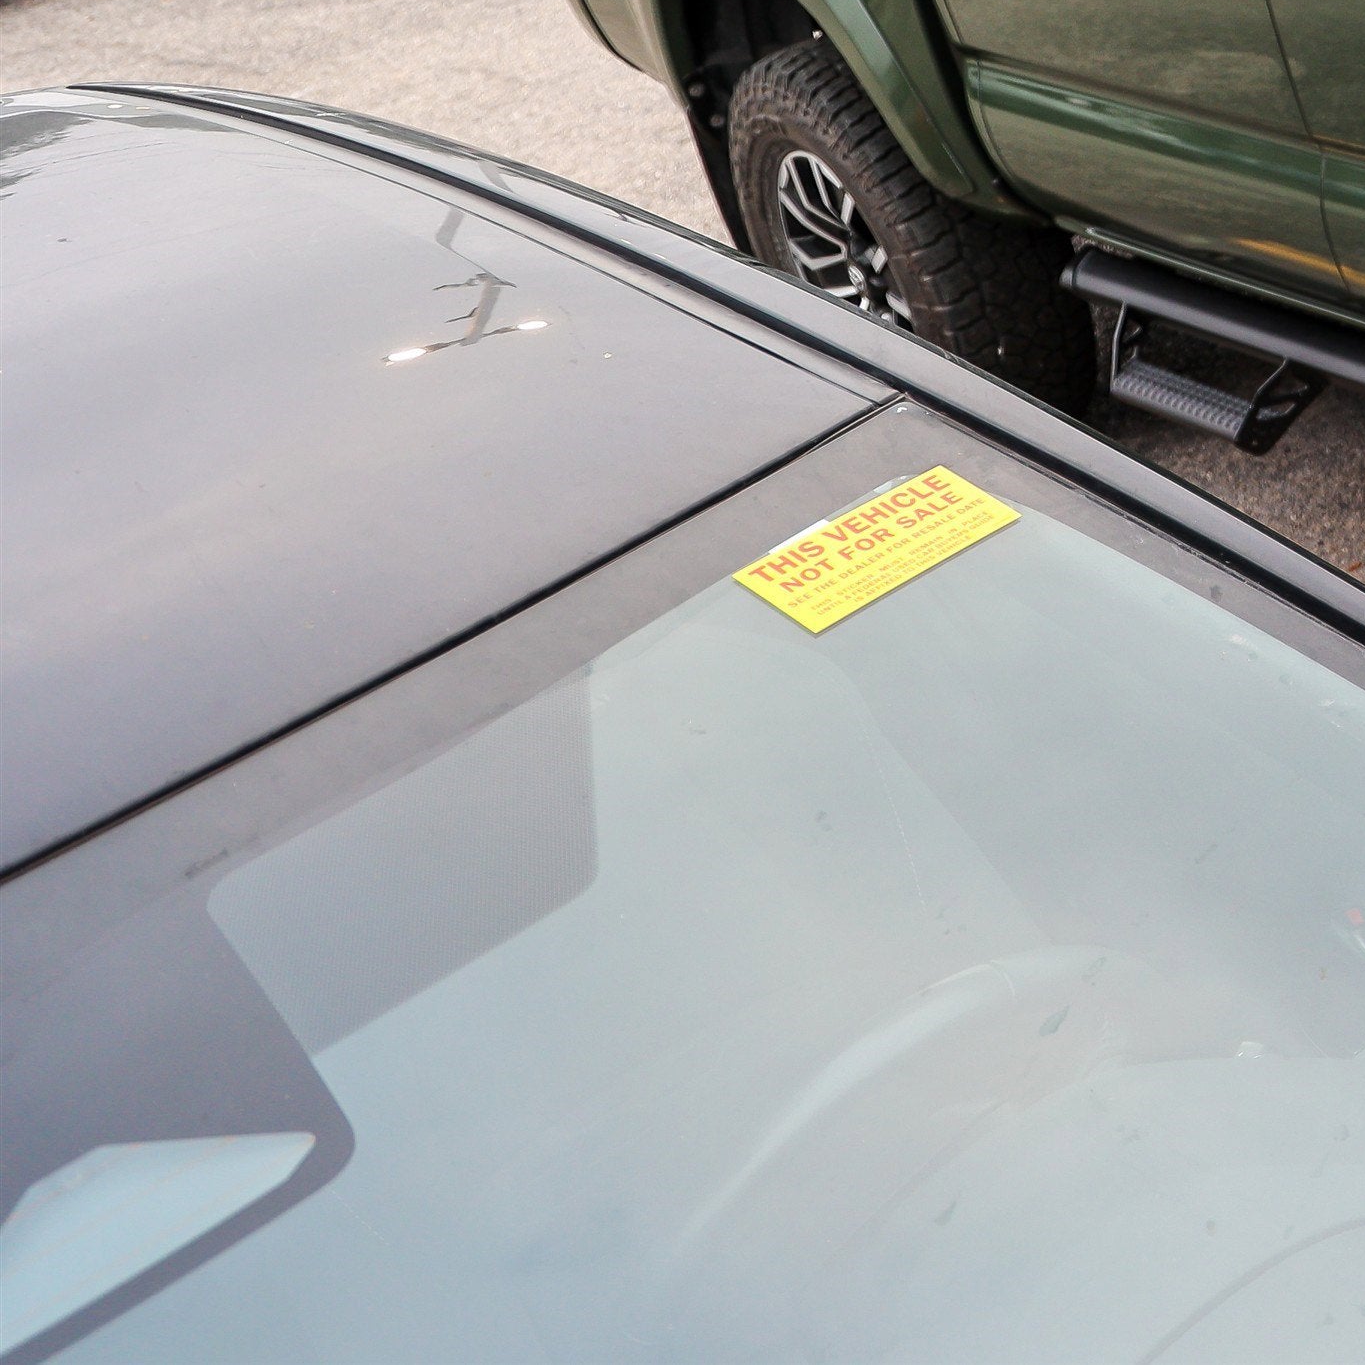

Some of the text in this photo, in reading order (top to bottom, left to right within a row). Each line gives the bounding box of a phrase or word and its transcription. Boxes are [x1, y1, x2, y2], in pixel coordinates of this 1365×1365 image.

[748, 474, 951, 583] THIS VEHICLE
[779, 491, 964, 593] NOT FOR SALE
[787, 498, 985, 608] SEE THE DEALER FOR RESALE DATE
[835, 574, 874, 597] STICKER
[879, 556, 904, 573] MUST
[909, 535, 943, 557] REMAIN
[817, 599, 845, 616] UNTIL
[850, 572, 892, 596] FEDERAL
